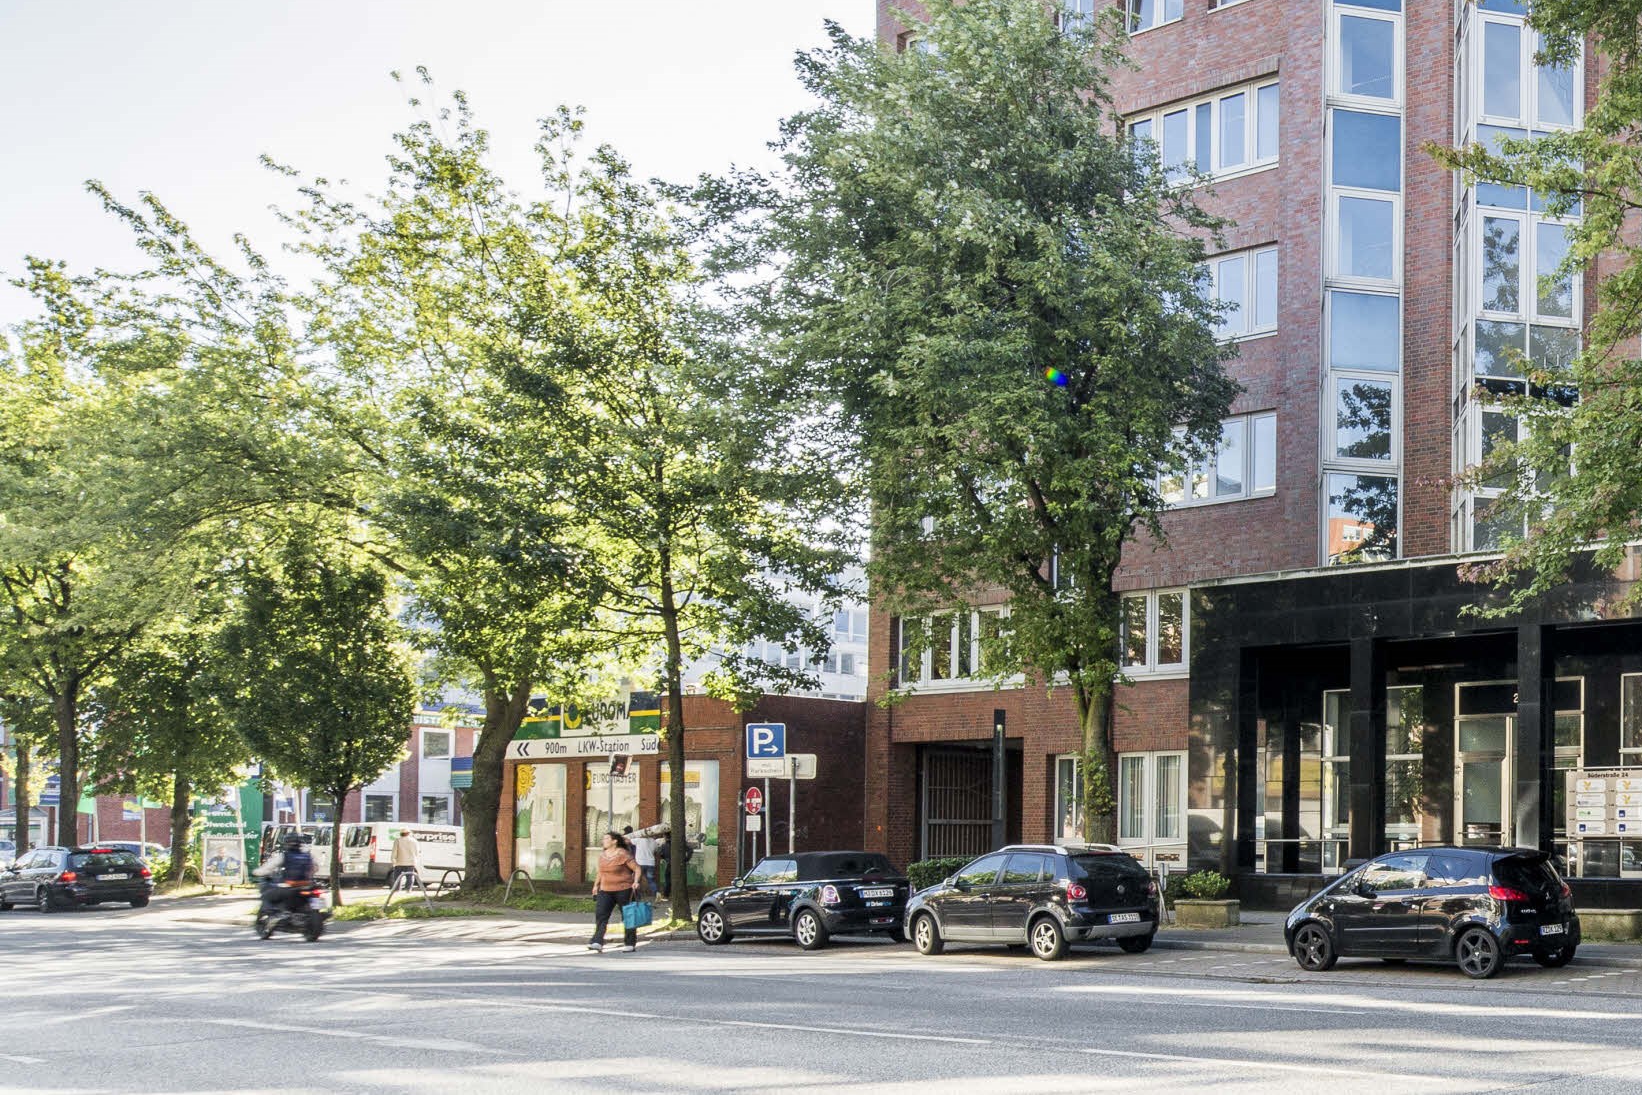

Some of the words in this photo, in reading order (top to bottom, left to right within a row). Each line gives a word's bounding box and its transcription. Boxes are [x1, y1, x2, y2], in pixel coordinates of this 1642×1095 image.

[545, 741, 567, 754] 900m
[578, 739, 630, 753] LKW-Station
[753, 728, 774, 754] P
